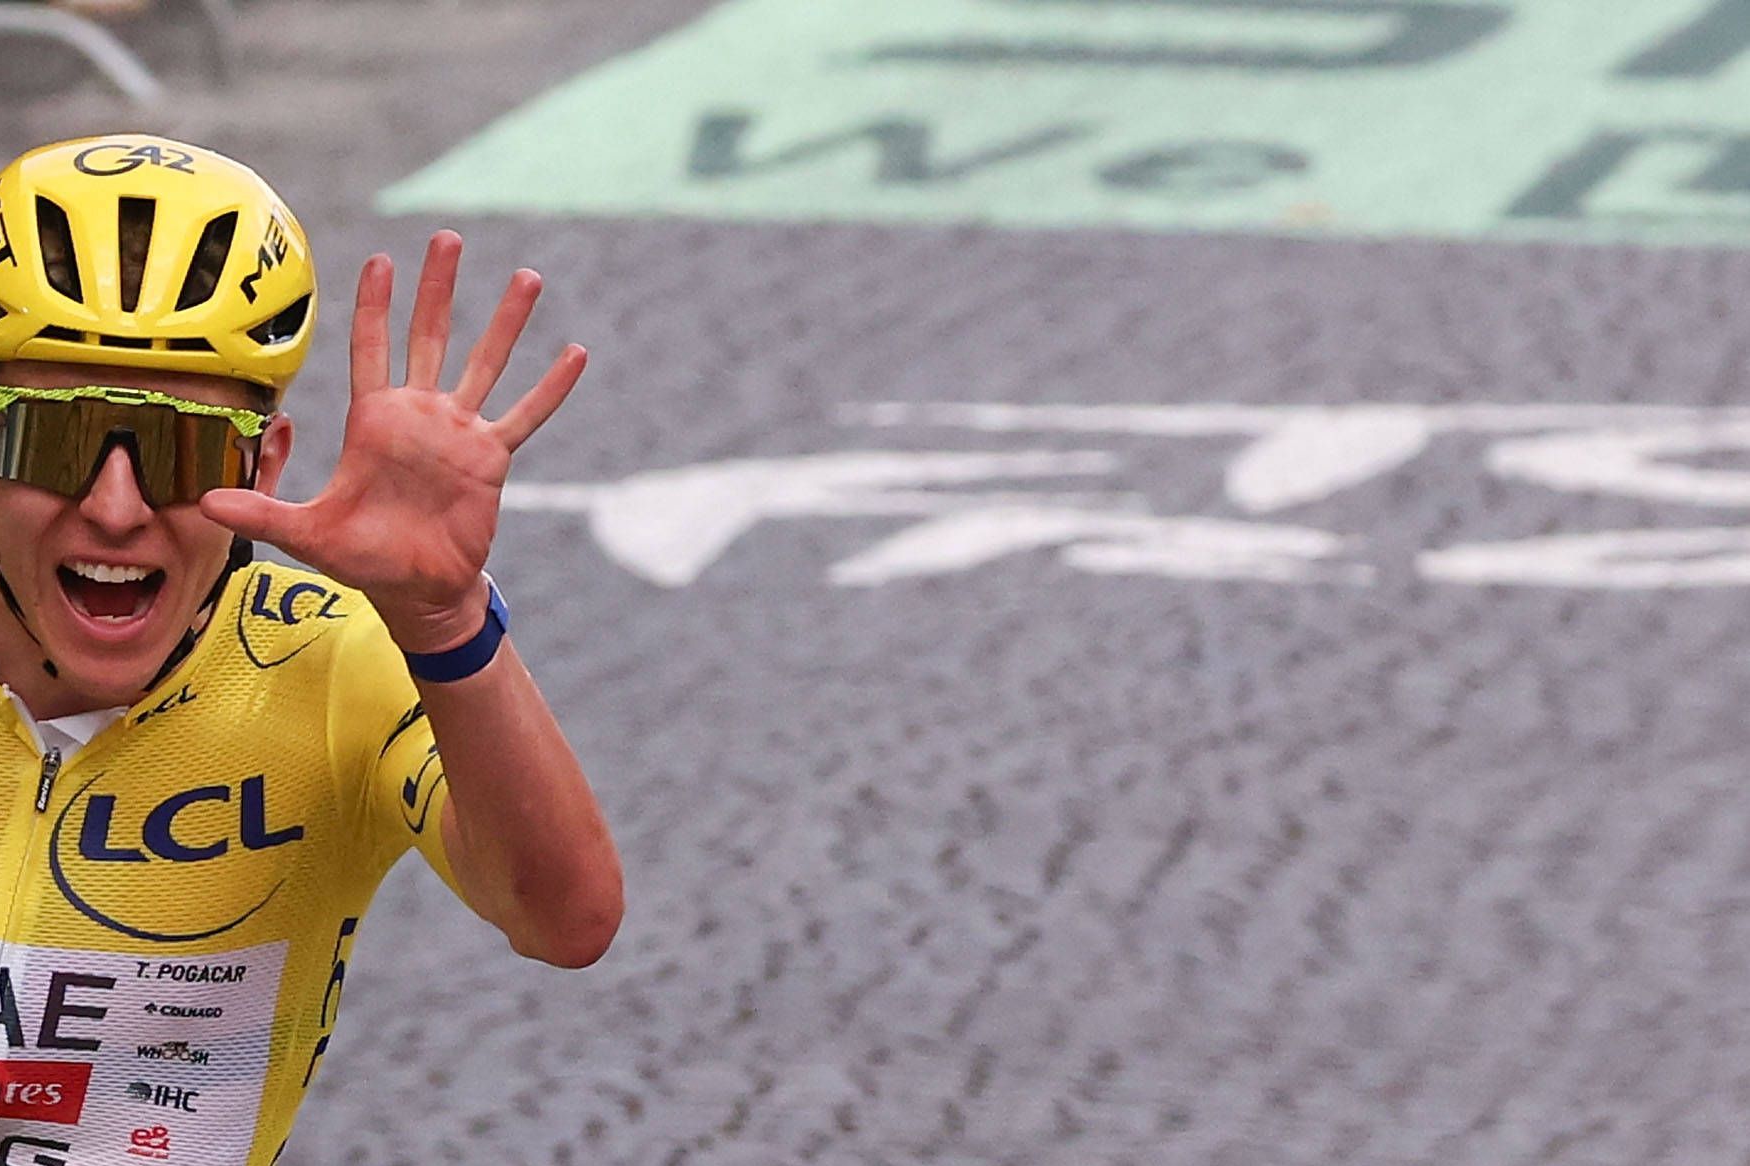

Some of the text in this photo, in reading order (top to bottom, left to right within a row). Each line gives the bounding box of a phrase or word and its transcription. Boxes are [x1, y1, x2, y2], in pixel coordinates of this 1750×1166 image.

[251, 573, 348, 625] LCL
[78, 774, 304, 862] LCL
[136, 961, 150, 979] T.
[154, 1084, 200, 1113] IHC
